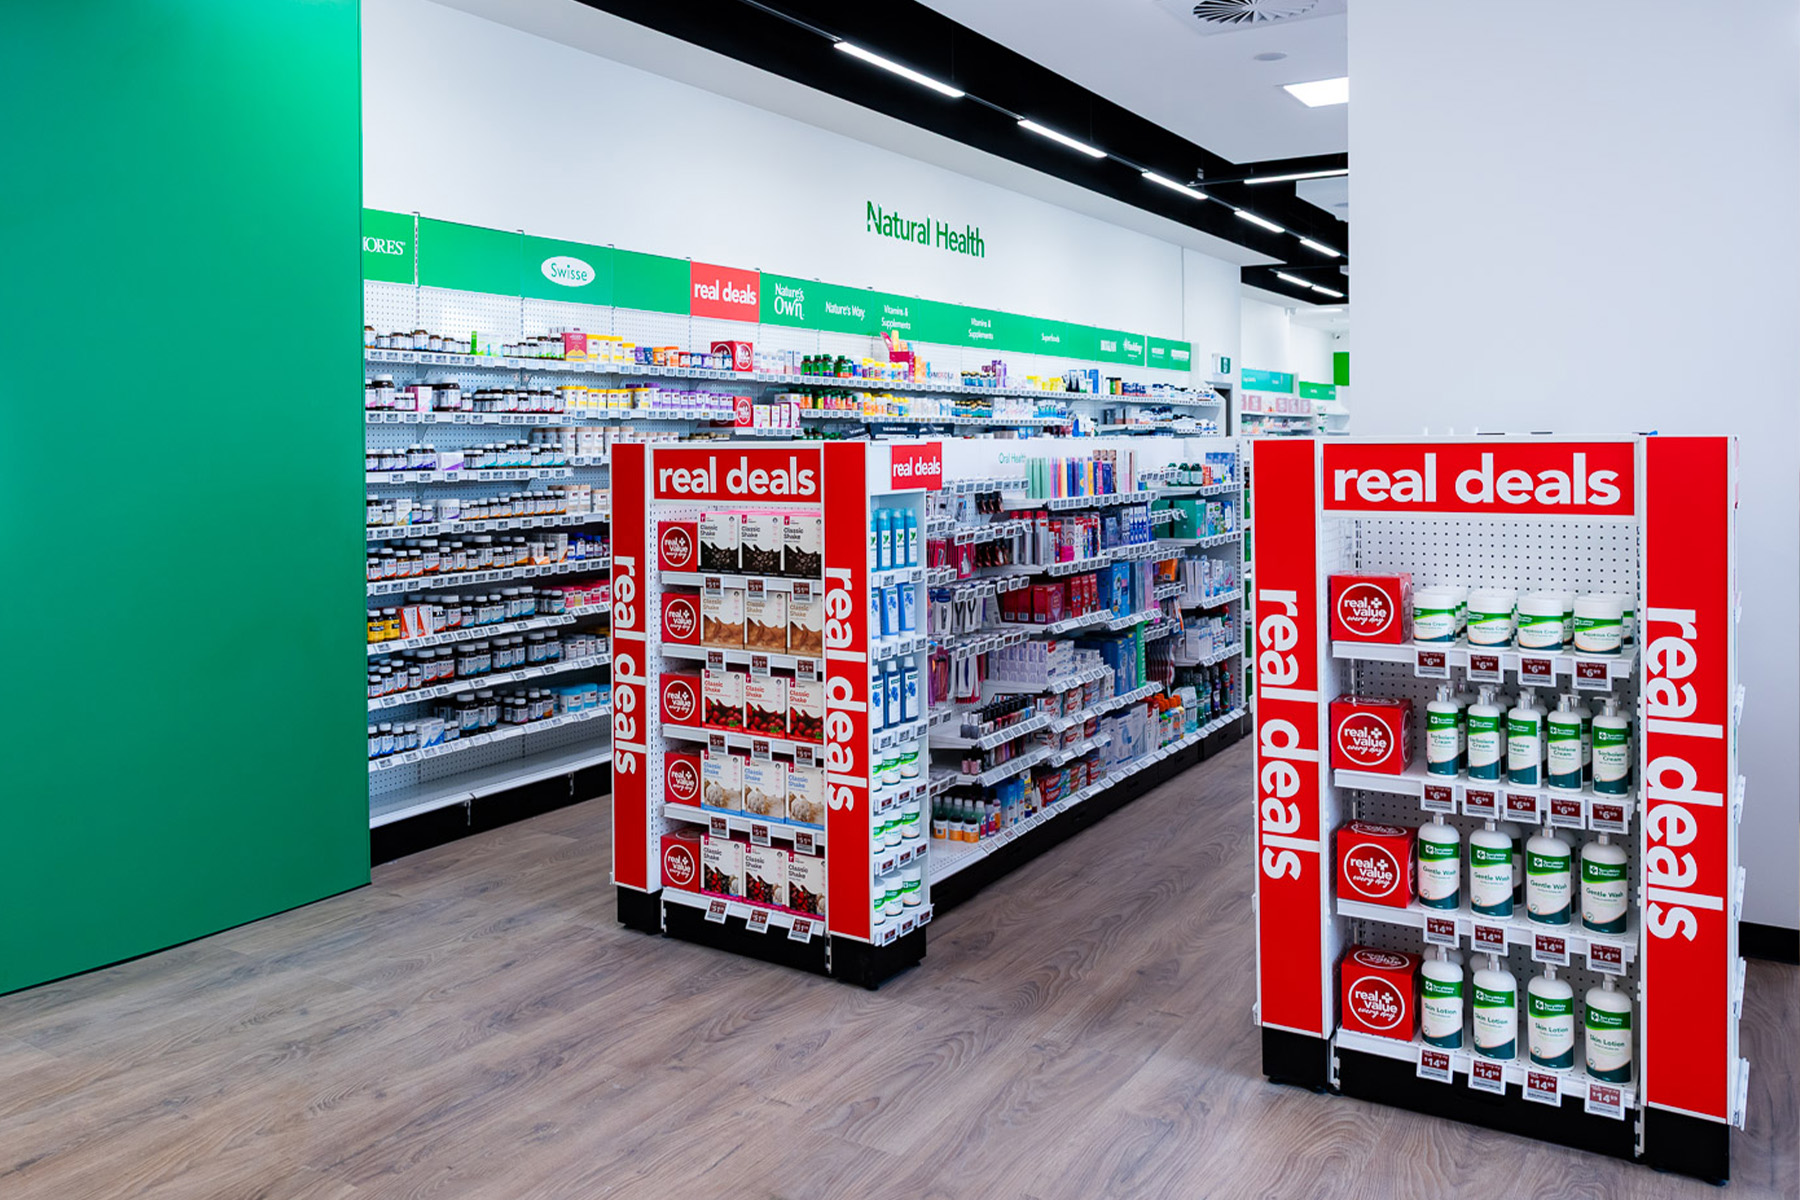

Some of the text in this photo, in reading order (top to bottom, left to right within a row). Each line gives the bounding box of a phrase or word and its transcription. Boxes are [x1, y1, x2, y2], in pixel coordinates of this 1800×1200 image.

[867, 200, 985, 258] Natural Health
[550, 262, 588, 282] Swisse
[694, 280, 757, 305] real deals
[775, 283, 804, 300] Nature's
[774, 297, 804, 320] Own
[825, 301, 865, 321] Nature's Way
[998, 452, 1010, 464] Oral
[893, 455, 941, 477] real deals
[659, 456, 816, 496] real deals
[1334, 452, 1621, 506] real deals
[1344, 597, 1368, 608] real
[668, 610, 682, 618] real
[1353, 606, 1387, 618] value
[613, 555, 646, 775] real deals
[667, 691, 681, 700] real
[825, 567, 868, 812] real deals
[1259, 589, 1320, 880] real deals
[1344, 727, 1368, 738] real
[1353, 735, 1387, 748] value
[671, 770, 685, 779] real
[1646, 607, 1723, 942] real deals
[667, 855, 681, 864] real
[1350, 857, 1374, 869] real
[1359, 866, 1393, 881] value
[1352, 875, 1391, 889] every day
[1530, 879, 1552, 889] Gentle
[1586, 887, 1607, 898] Gentle
[1355, 990, 1379, 1001] real
[1364, 1000, 1398, 1014] value
[1436, 1006, 1457, 1015] Lotion
[1358, 1007, 1396, 1022] every day
[1487, 1016, 1508, 1025] Lotion
[1535, 1022, 1548, 1032] Skin
[1589, 1034, 1625, 1047] Skin Lotion
